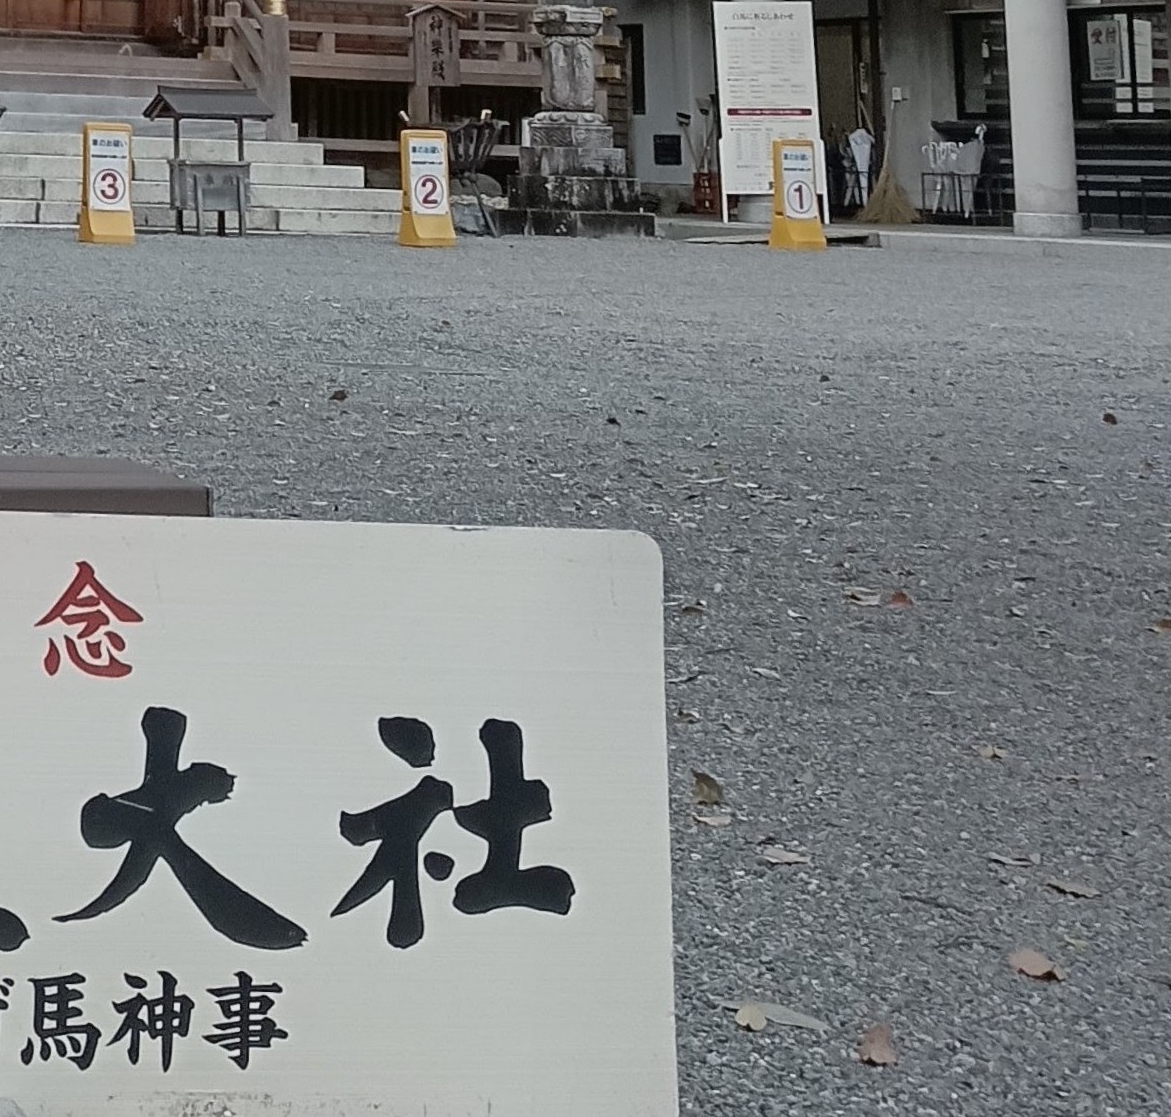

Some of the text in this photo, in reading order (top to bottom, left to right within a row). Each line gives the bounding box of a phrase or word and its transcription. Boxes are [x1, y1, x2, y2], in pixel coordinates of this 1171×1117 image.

[100, 172, 119, 200] 3
[421, 177, 438, 204] 2
[793, 184, 804, 210] 1
